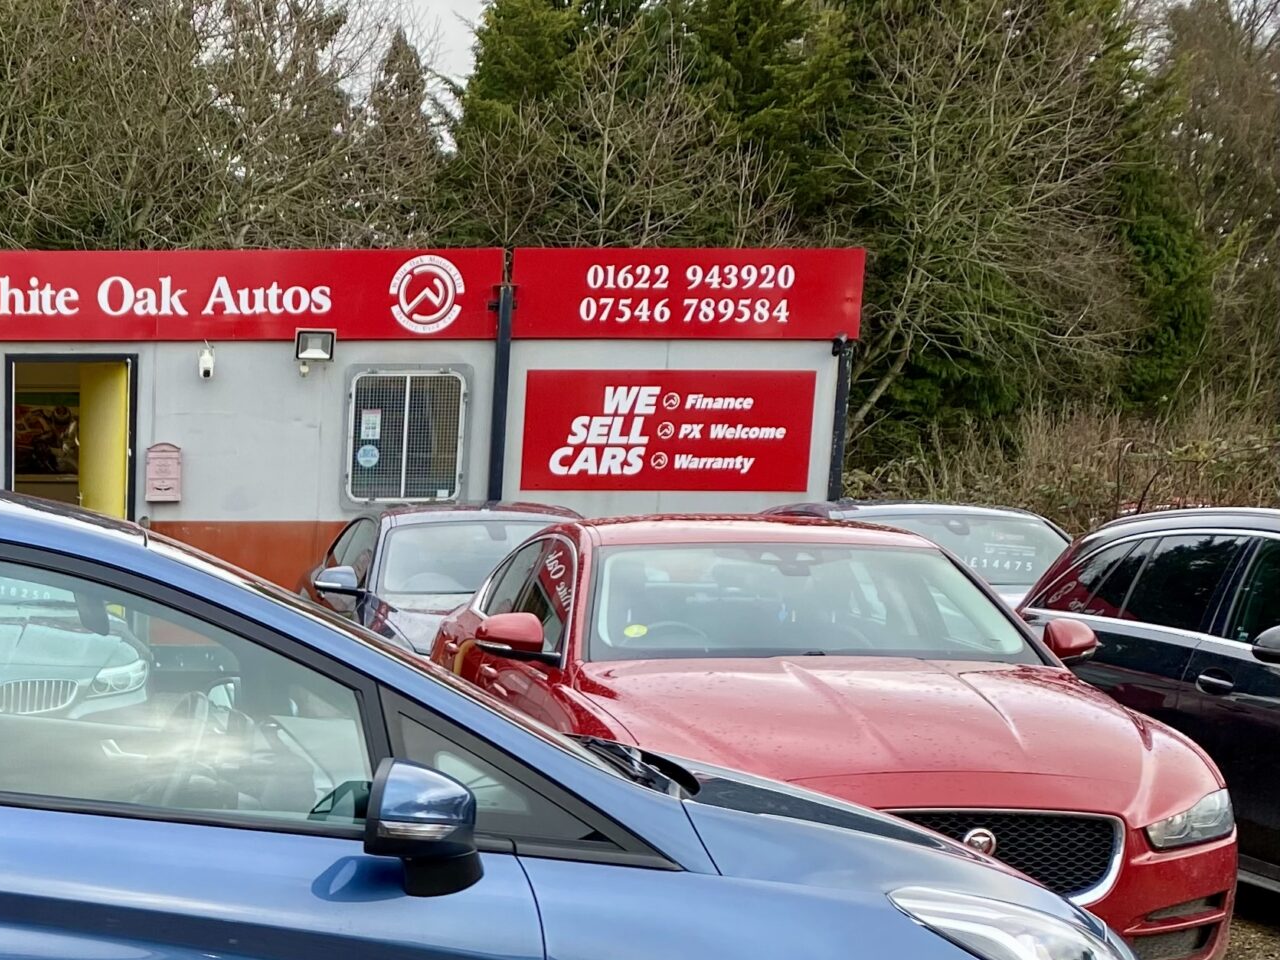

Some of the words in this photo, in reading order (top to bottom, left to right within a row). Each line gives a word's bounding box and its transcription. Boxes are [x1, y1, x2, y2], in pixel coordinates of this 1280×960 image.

[586, 264, 670, 289] 01622
[685, 264, 796, 290] 943920
[96, 275, 189, 317] Oak
[201, 276, 332, 316] Autos
[579, 297, 671, 323] 07546
[683, 298, 790, 324] 789584
[603, 385, 662, 415] WE
[684, 393, 754, 410] Finance
[567, 415, 650, 446] SELL
[678, 423, 704, 440] PX
[709, 423, 787, 440] Welcome
[548, 446, 646, 476] CARS
[673, 453, 756, 474] Warranty
